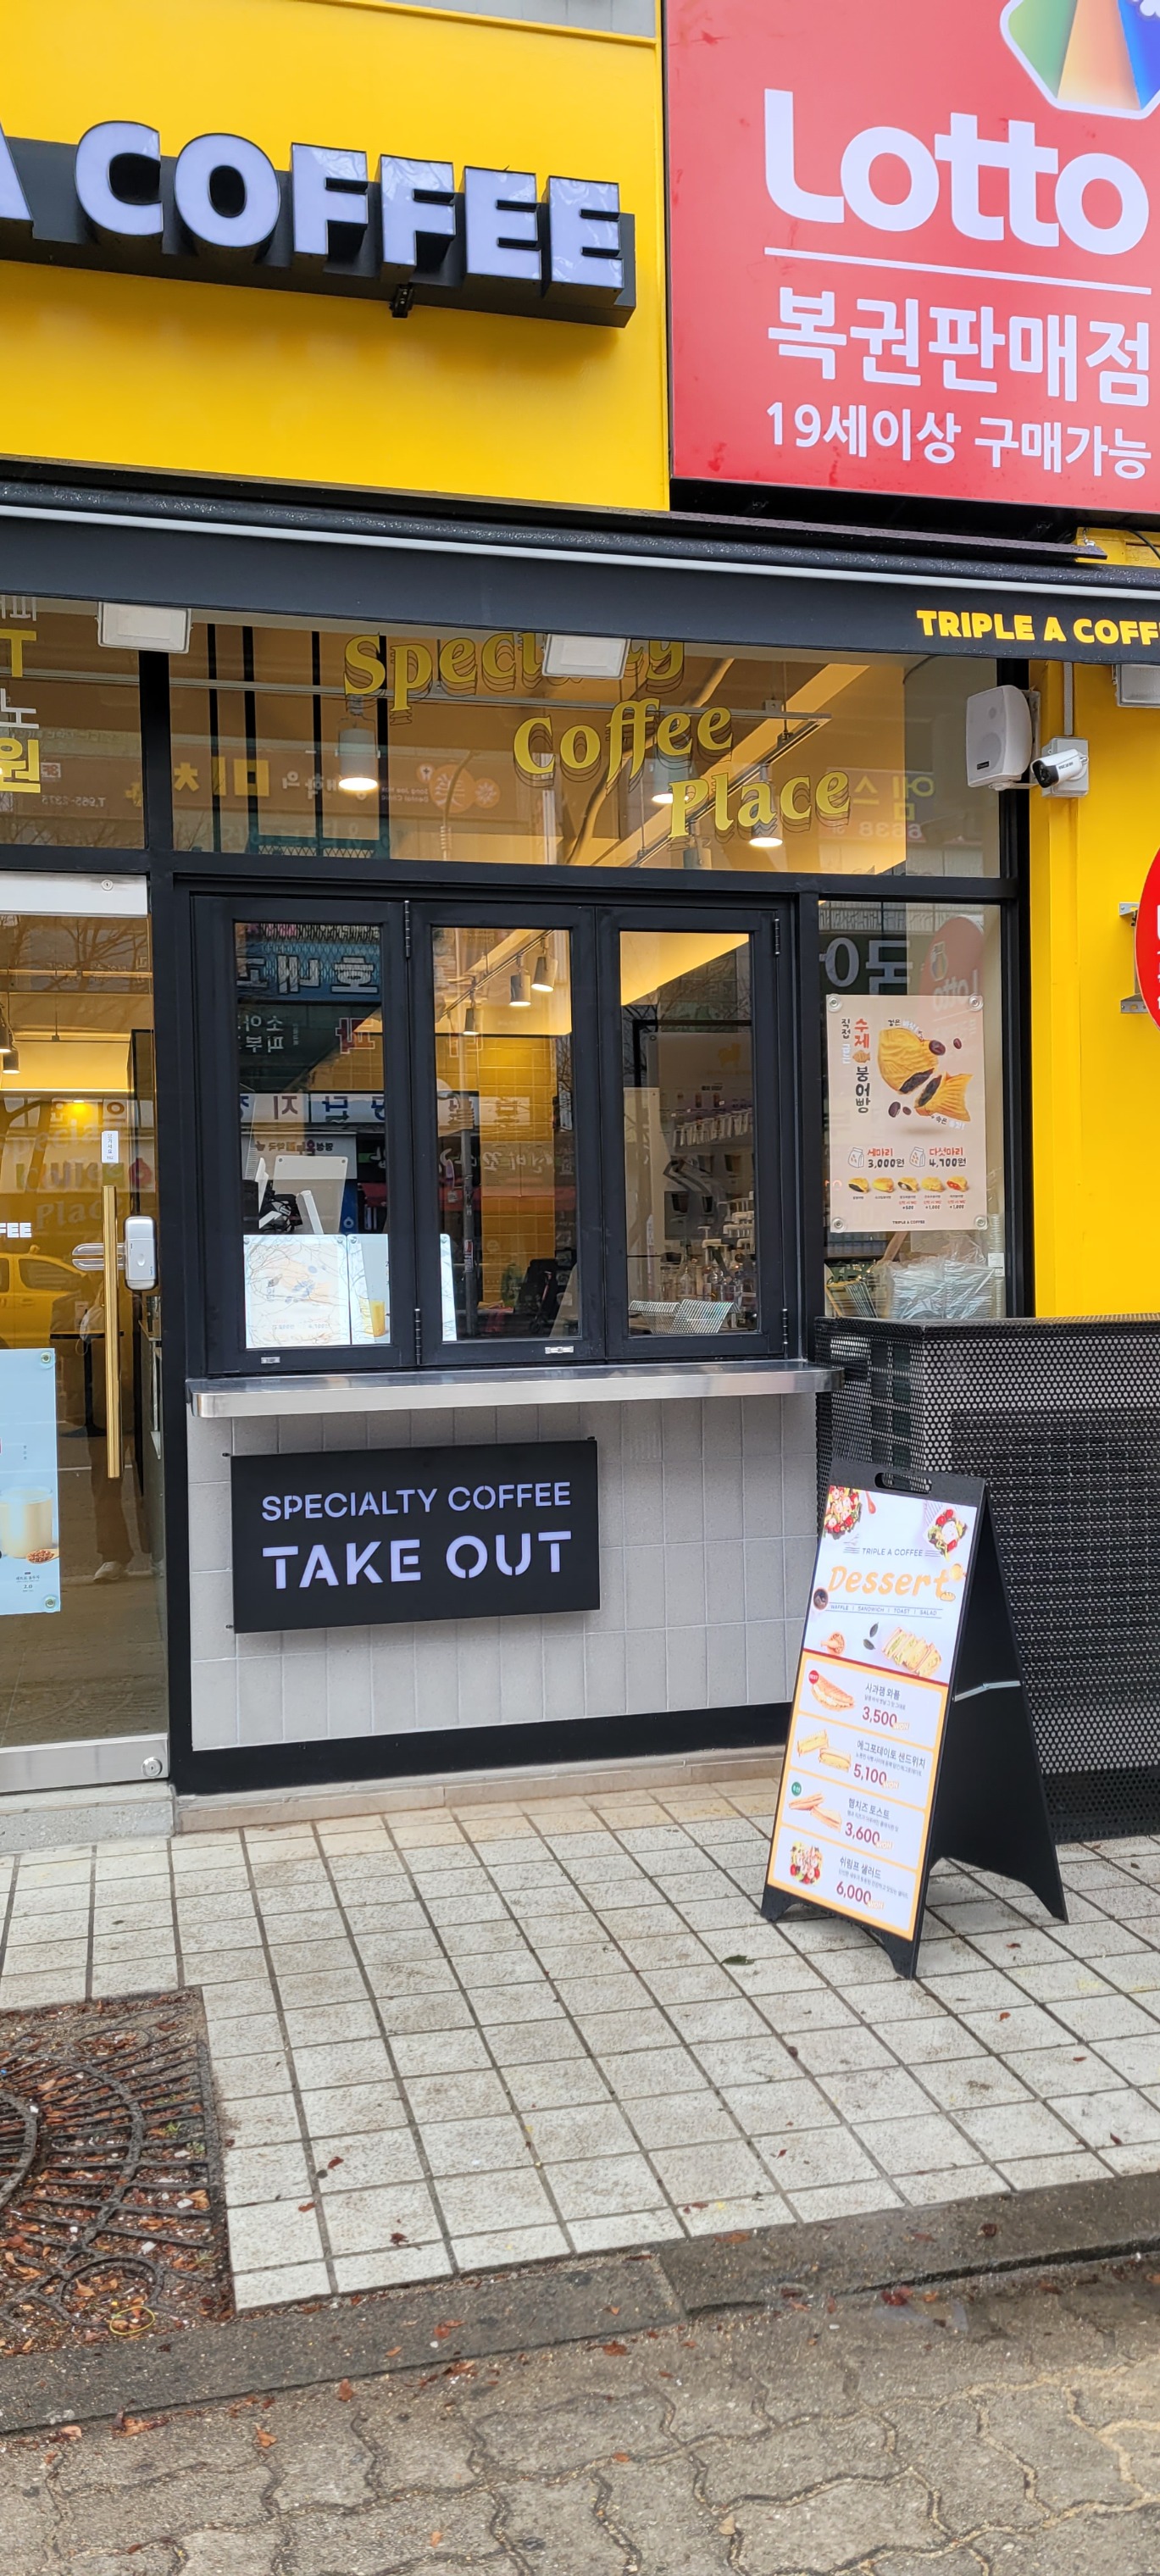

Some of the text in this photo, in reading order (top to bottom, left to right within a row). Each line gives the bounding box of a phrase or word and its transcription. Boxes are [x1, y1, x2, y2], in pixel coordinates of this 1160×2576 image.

[764, 88, 1150, 255] Lotto
[74, 119, 624, 289] COFFEE
[768, 286, 1150, 408] 복권판매점
[766, 402, 1152, 480] 19세이상 구매가능
[916, 609, 1160, 646] TRIPLE A COFF
[513, 697, 734, 781] Coffee
[668, 770, 851, 839] Place
[854, 1019, 871, 1113] 수제 붕어빵
[867, 1146, 963, 1158] 세마리 다섯마리
[868, 1158, 967, 1169] 3,000원 4,700원
[261, 1481, 571, 1522] SPECIALTY COFFEE
[262, 1530, 572, 1590] TAKE OUT
[862, 1547, 886, 1556] TRIPLE
[894, 1547, 924, 1557] COFFEE
[828, 1565, 951, 1599] Dessert
[865, 1682, 901, 1701] 사과잼 와플
[862, 1706, 897, 1728] 3,500
[857, 1740, 926, 1769] 에그포테이토 샌드위치
[853, 1763, 887, 1786] 5,100
[848, 1797, 890, 1820] 햄치즈 토스트
[845, 1822, 880, 1846] 3,600
[840, 1856, 881, 1879] 쉬림프 샐러드
[836, 1880, 872, 1906] 6,000
